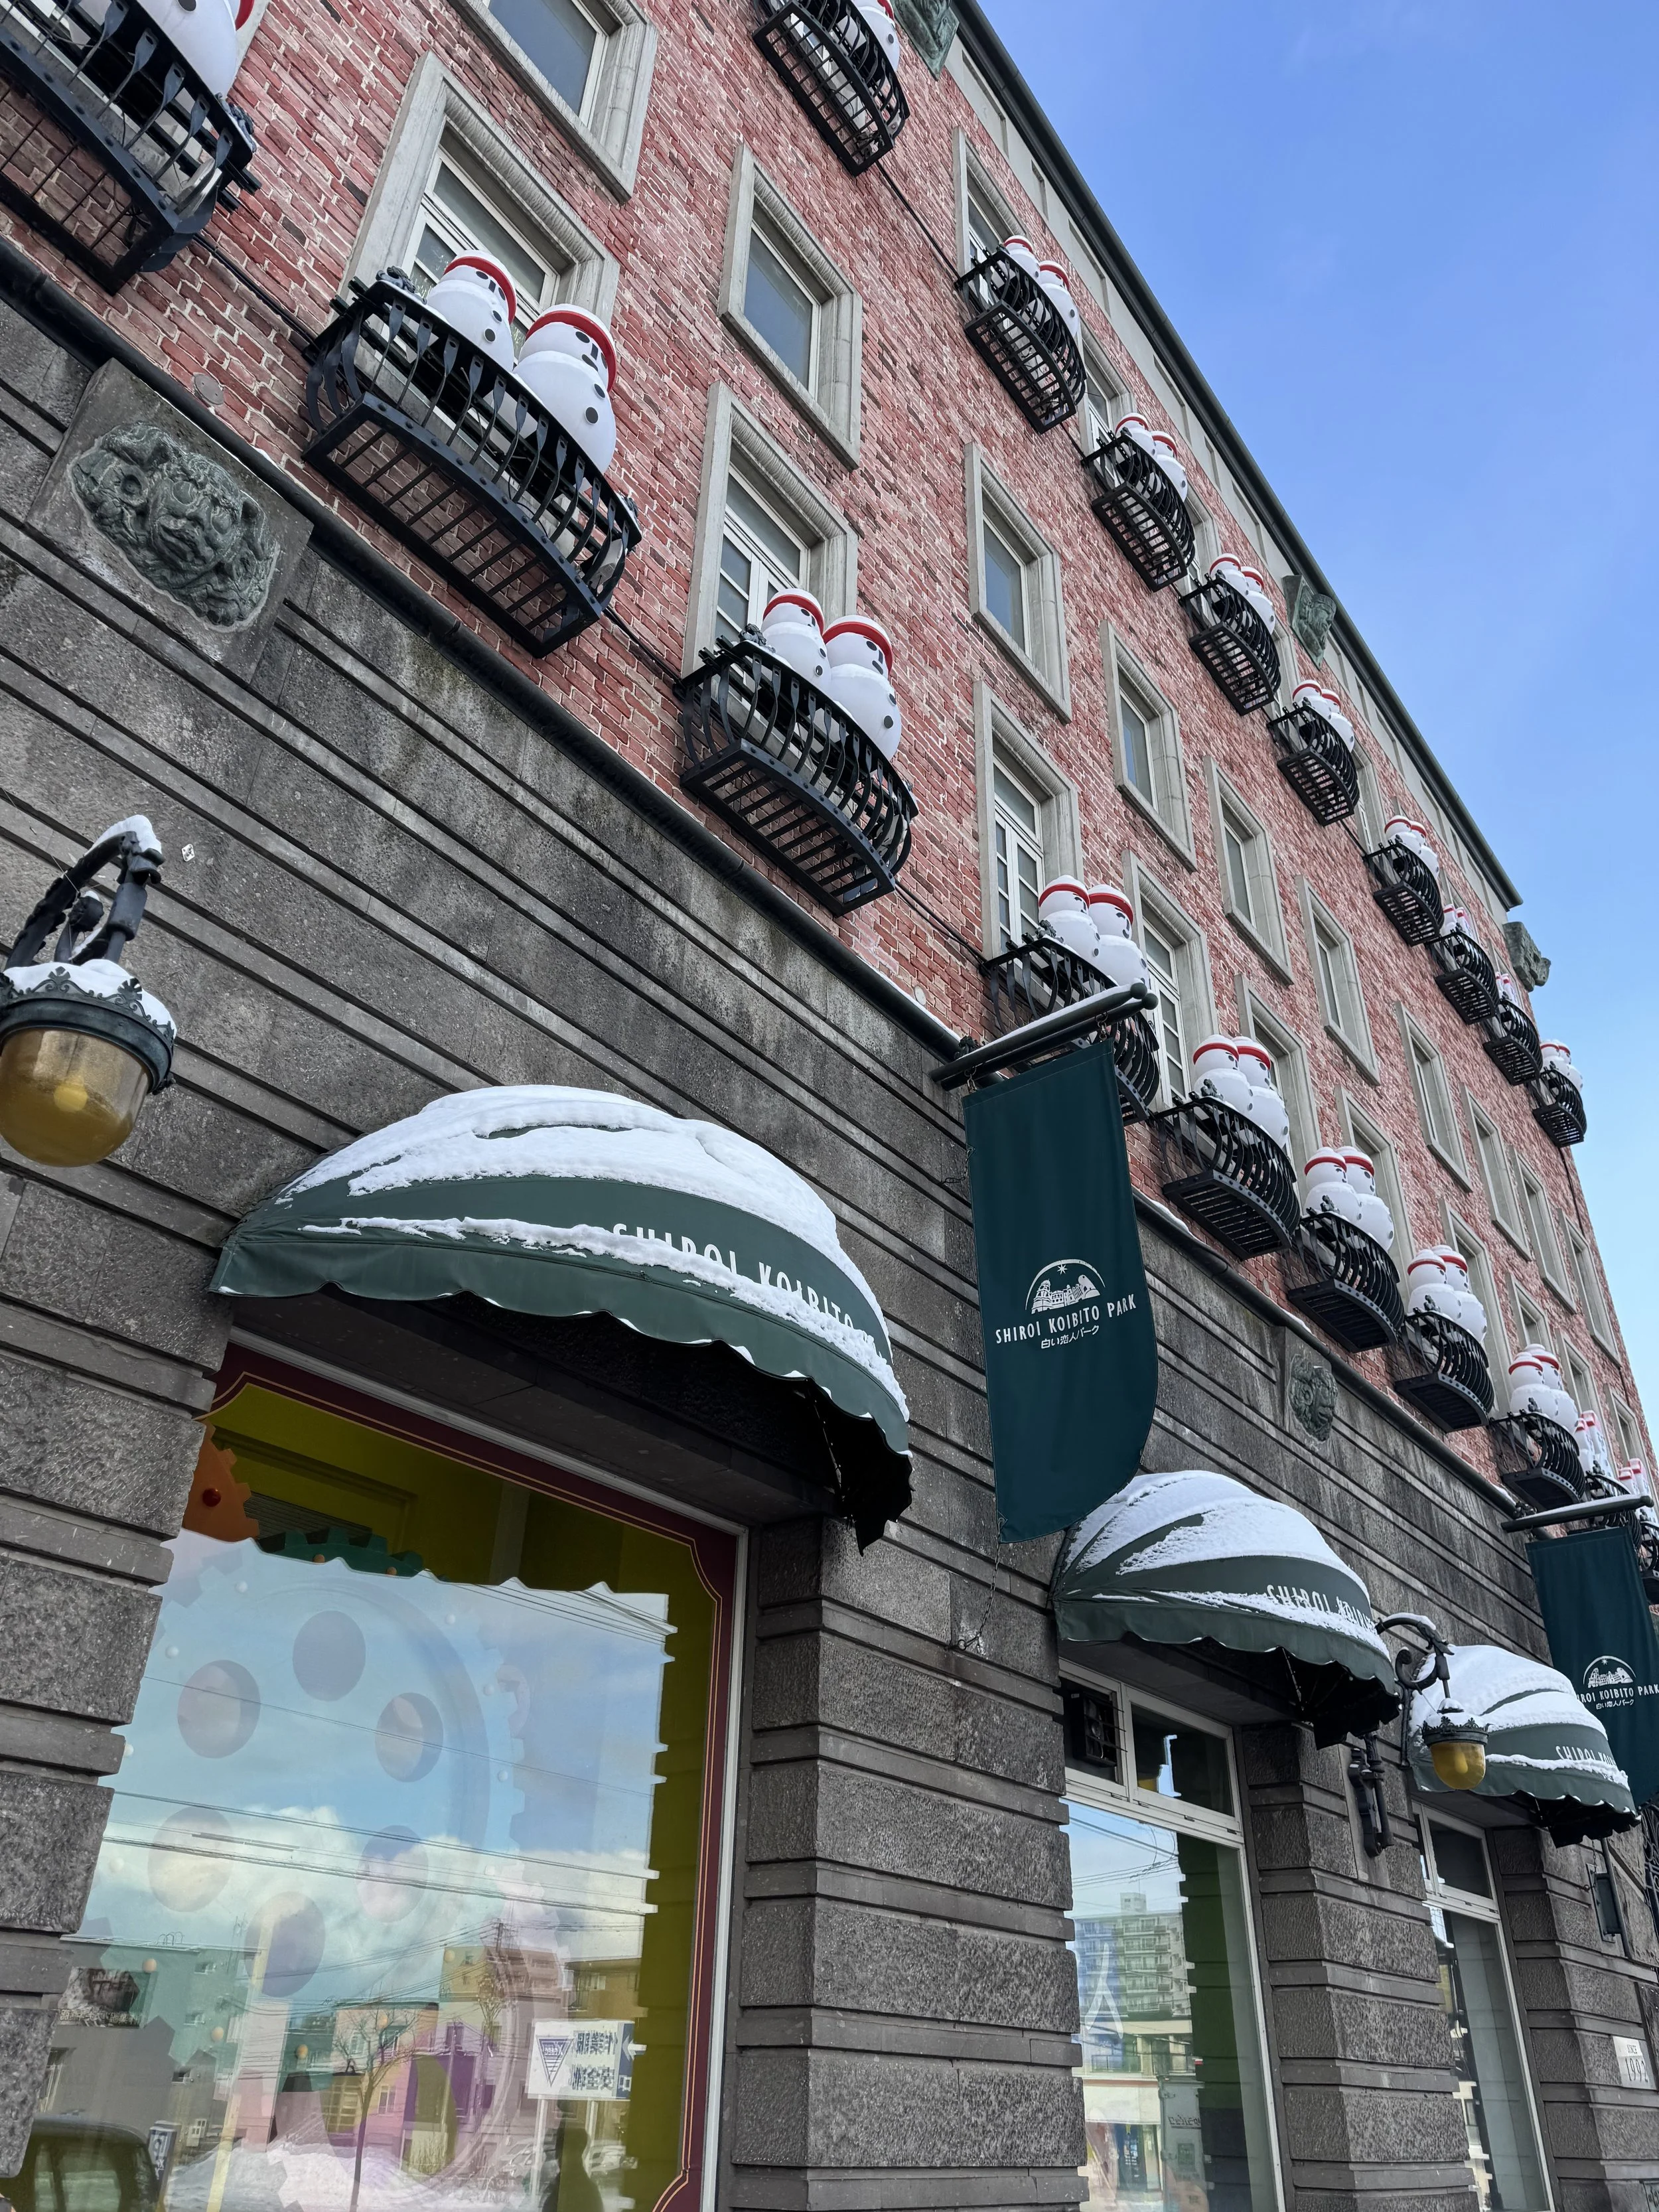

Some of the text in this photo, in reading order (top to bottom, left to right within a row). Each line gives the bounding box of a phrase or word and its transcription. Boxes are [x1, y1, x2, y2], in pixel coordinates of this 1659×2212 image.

[995, 1293, 1137, 1344] SHIROI KOIBITO PARK
[1041, 1325, 1100, 1349] 白い恋人パーク
[1577, 1684, 1659, 1703] IROI KOIBITO PARK
[1625, 2057, 1648, 2082] 1992
